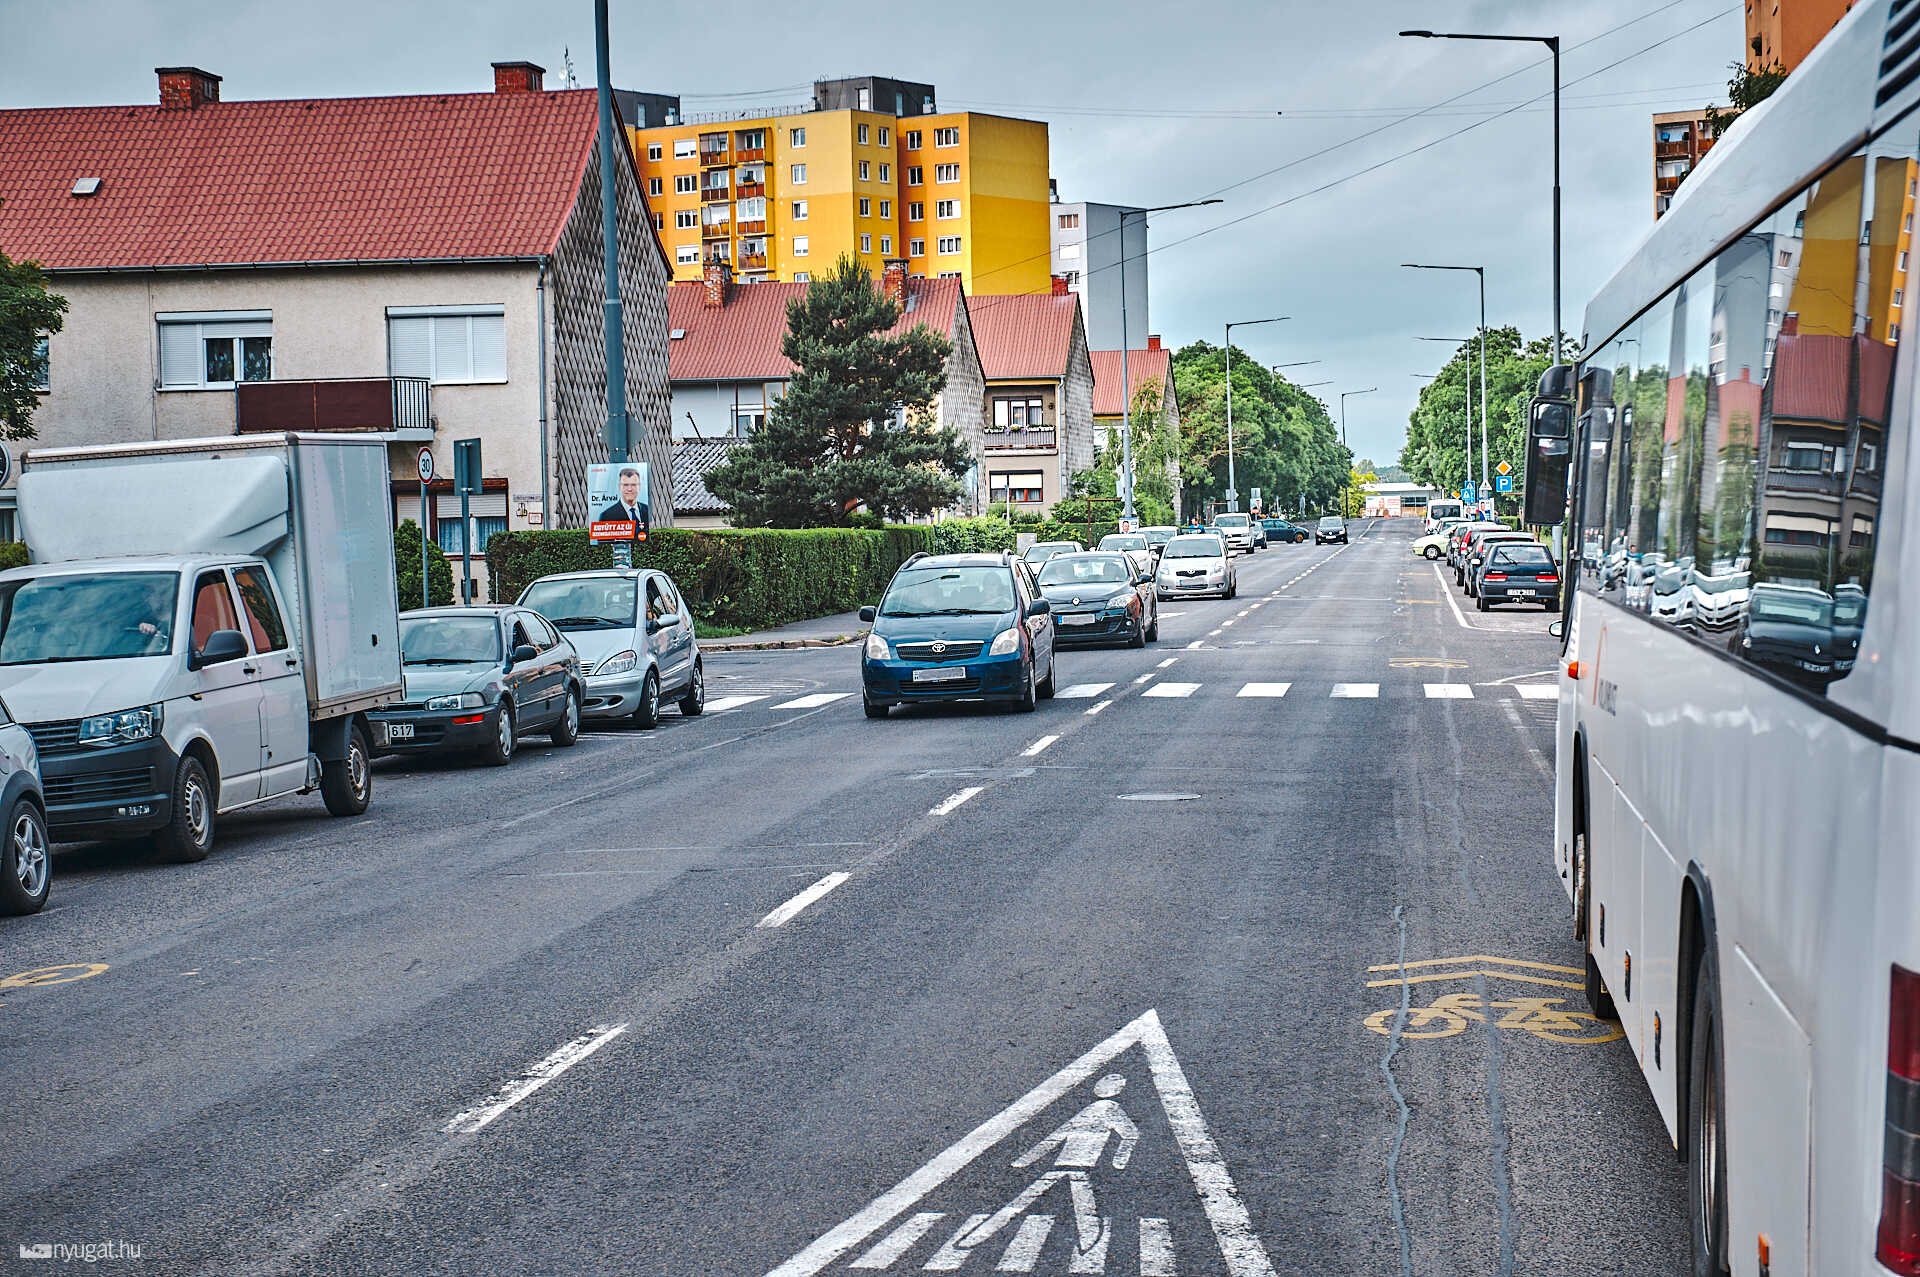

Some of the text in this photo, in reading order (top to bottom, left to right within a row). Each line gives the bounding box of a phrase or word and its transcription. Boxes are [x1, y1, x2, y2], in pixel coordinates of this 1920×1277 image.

[422, 459, 430, 472] 30
[1500, 479, 1508, 490] P
[392, 725, 412, 736] 617
